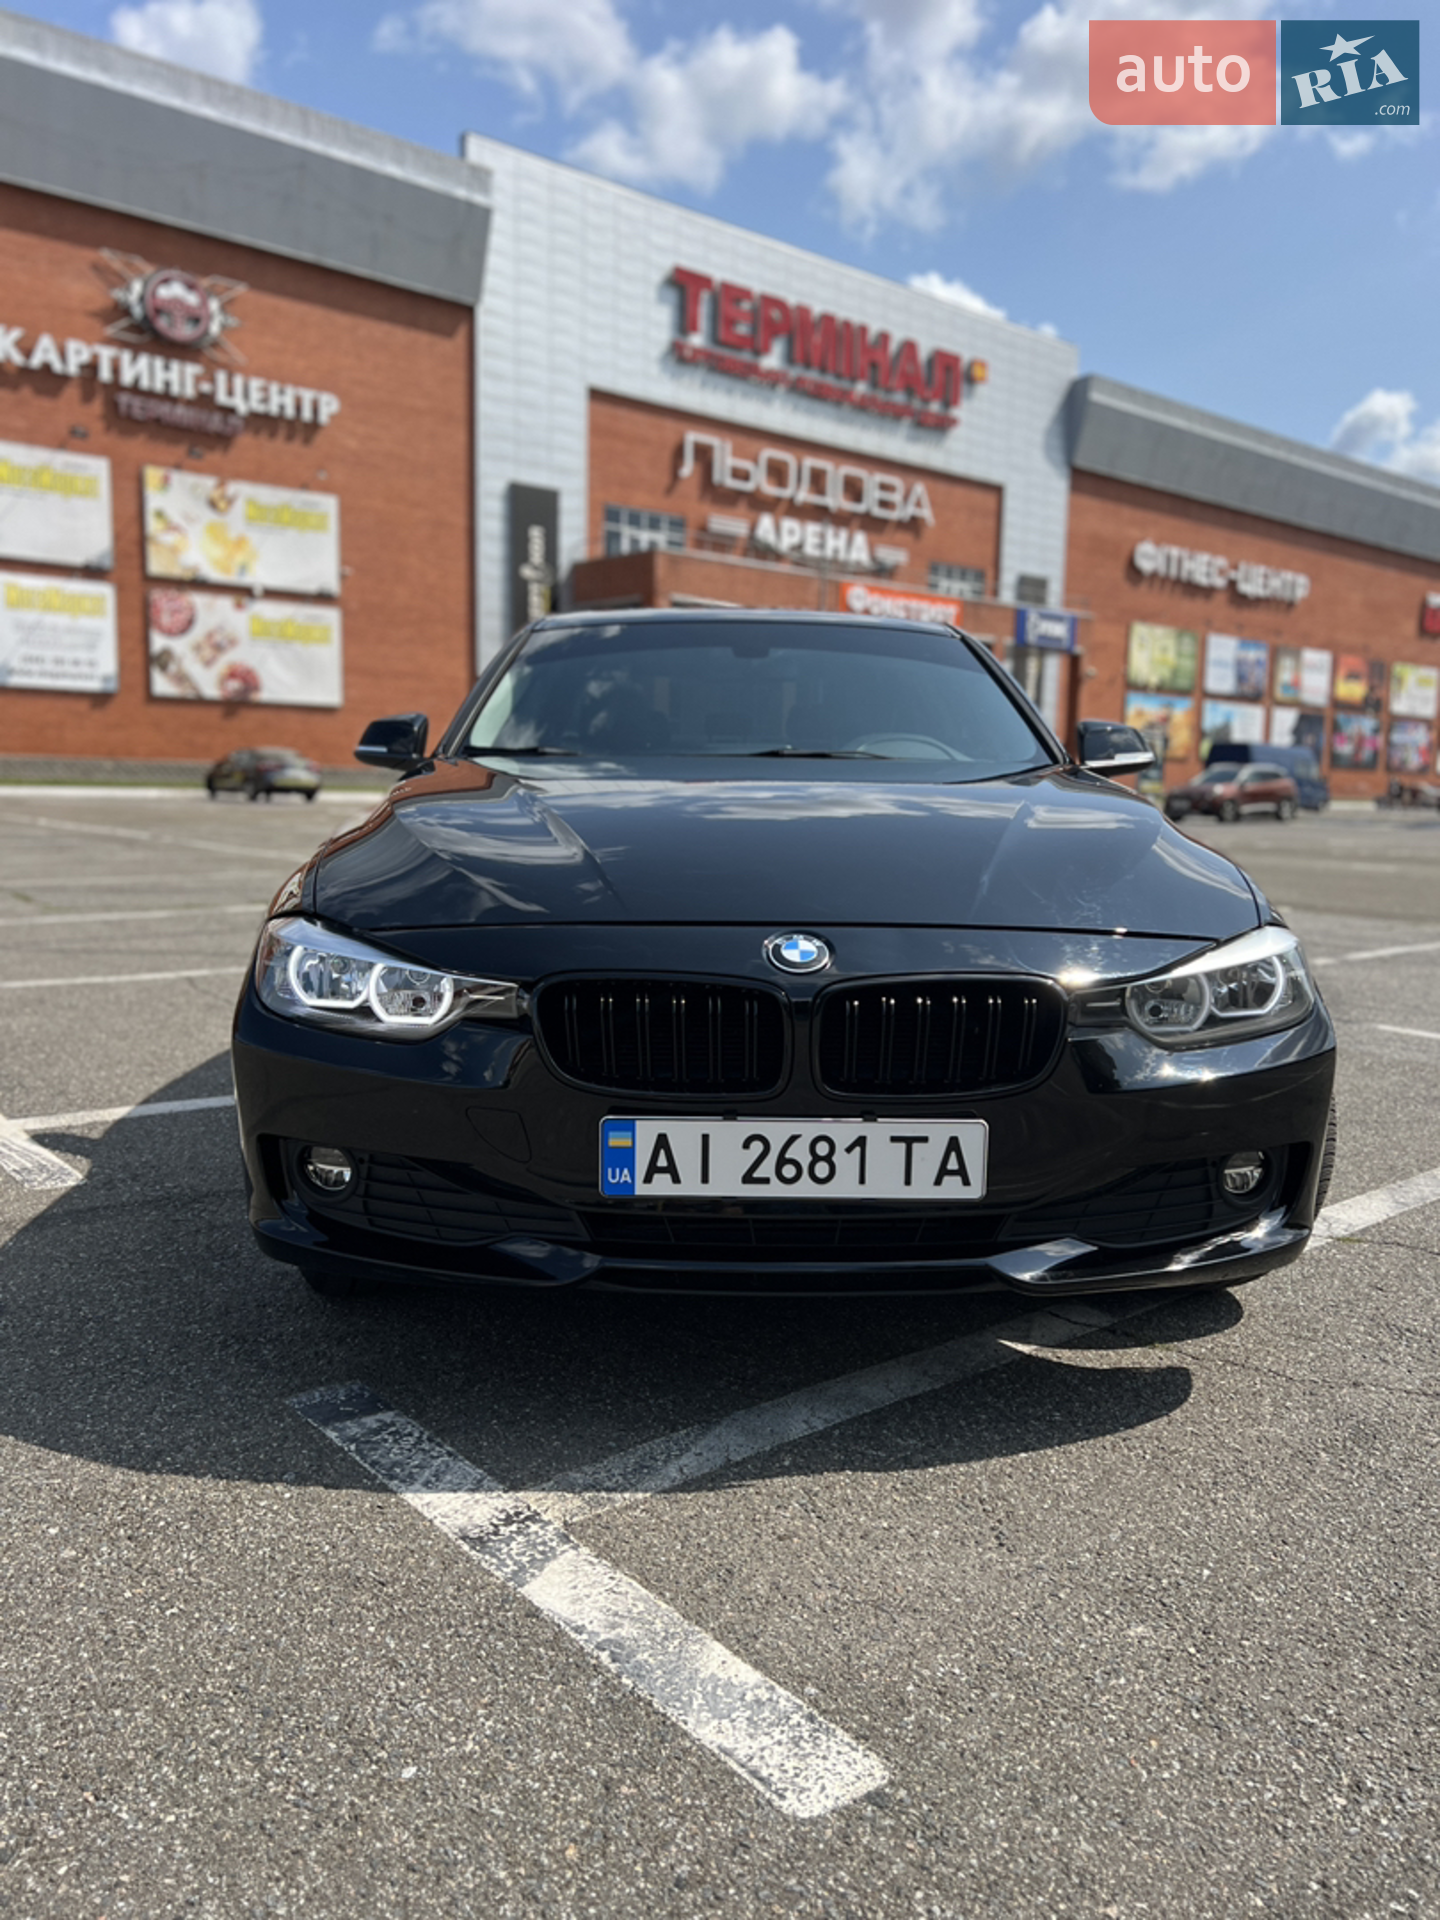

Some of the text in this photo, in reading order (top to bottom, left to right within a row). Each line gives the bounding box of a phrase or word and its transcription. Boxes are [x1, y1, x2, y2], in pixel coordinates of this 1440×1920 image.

[673, 264, 962, 408] ТЕРМІНАЛ
[0, 322, 341, 427] КАРТИНГ-ЦЕНТР
[678, 431, 936, 528] ЛЬОДОВА
[753, 511, 871, 566] АРЕНА
[606, 1167, 633, 1184] UA
[642, 1132, 972, 1187] AI 2681 TA
